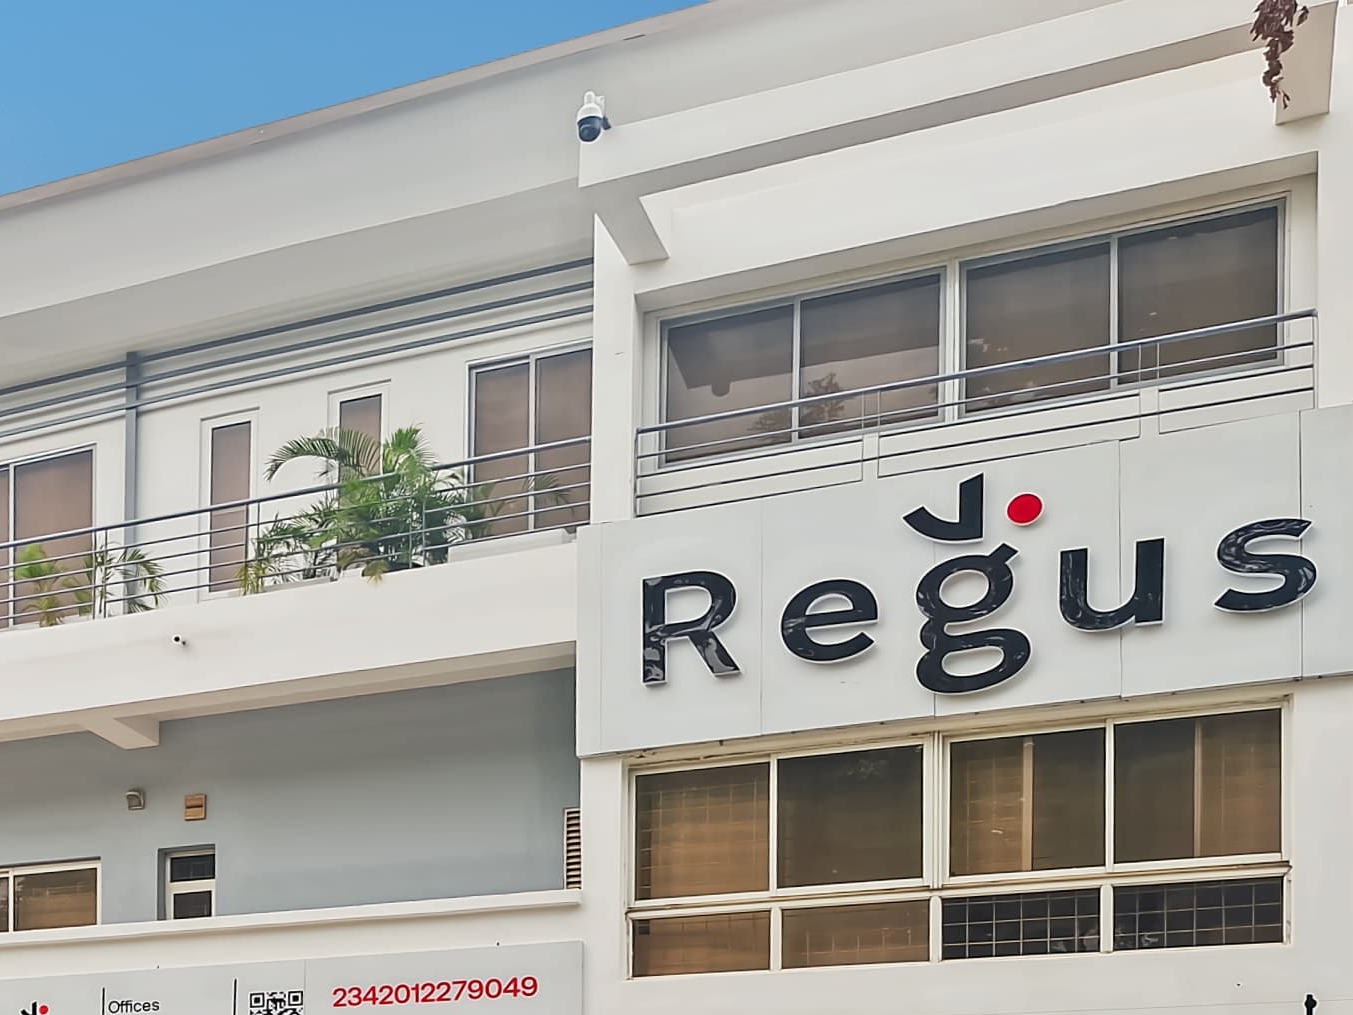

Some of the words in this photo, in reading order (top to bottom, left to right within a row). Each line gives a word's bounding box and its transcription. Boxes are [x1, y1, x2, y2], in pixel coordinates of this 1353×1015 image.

[641, 517, 1319, 694] Regus
[107, 998, 160, 1015] Offices
[332, 976, 539, 1008] 2342012279049
